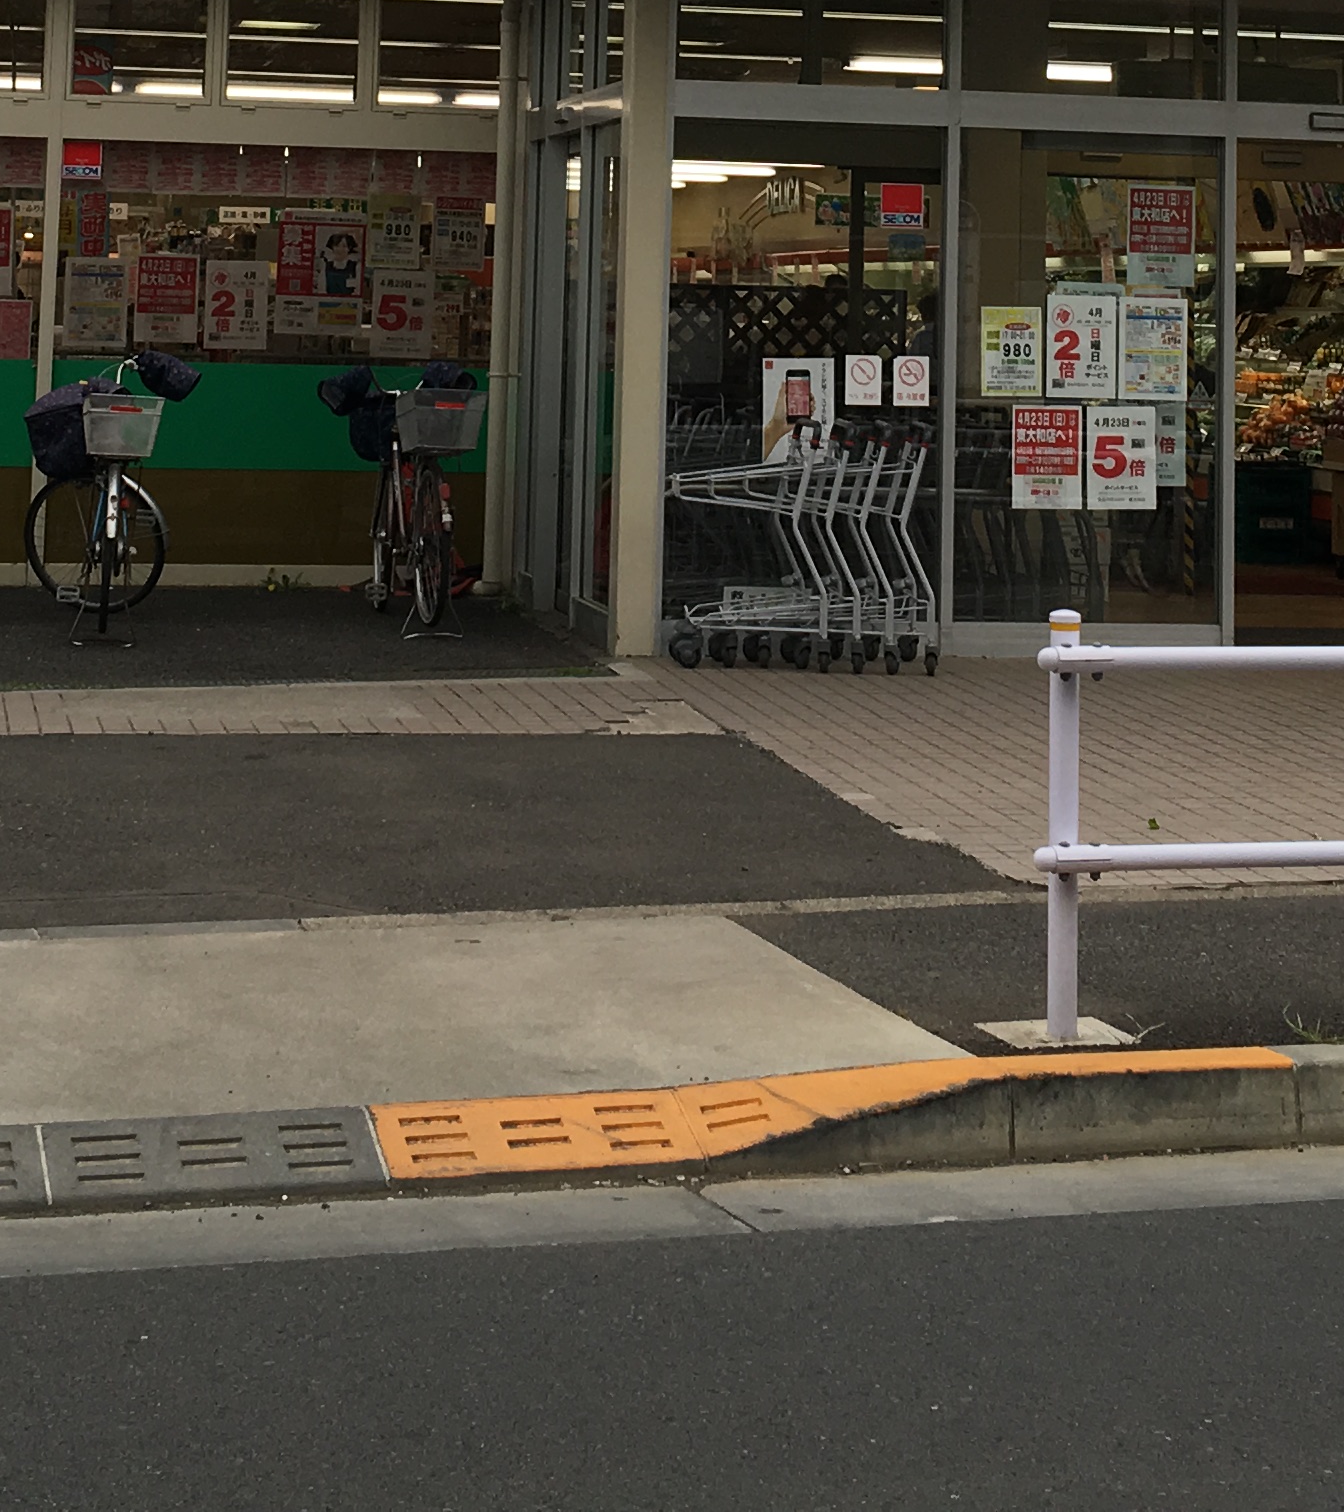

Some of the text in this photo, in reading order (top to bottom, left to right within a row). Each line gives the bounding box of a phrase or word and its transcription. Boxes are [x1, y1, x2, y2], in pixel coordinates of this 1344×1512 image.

[766, 176, 800, 215] DELICA
[883, 214, 921, 224] SECOM
[1002, 342, 1032, 358] 980
[1094, 417, 1130, 427] 4月23日
